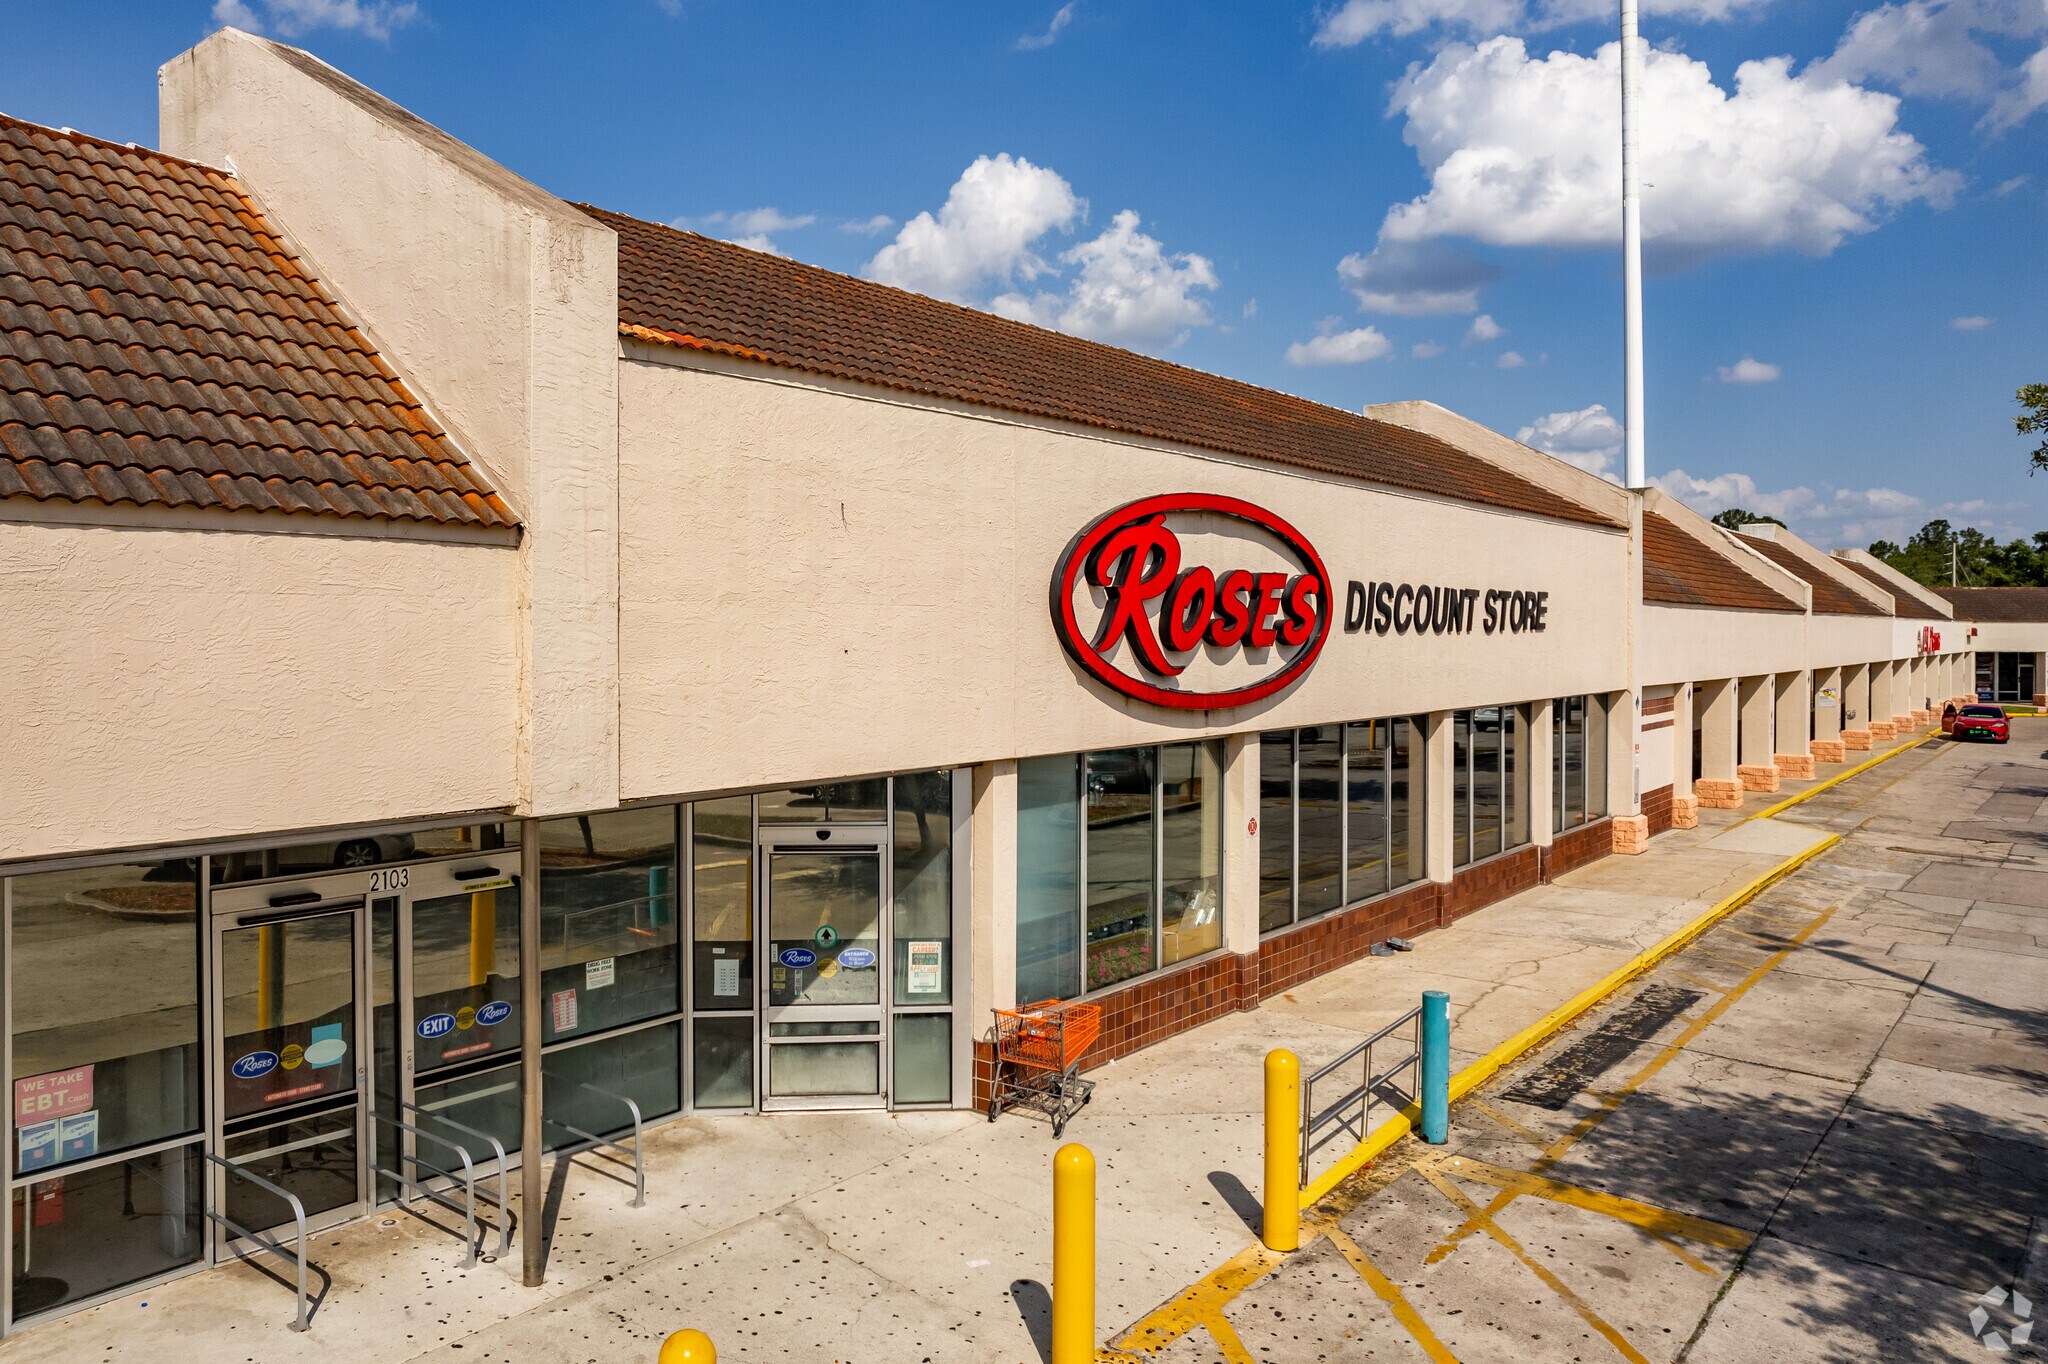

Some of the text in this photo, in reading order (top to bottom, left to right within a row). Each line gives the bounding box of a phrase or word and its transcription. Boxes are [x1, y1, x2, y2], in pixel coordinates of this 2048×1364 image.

[1085, 513, 1319, 676] ROSES
[1344, 580, 1549, 636] DISCOUNT STORE
[370, 868, 409, 892] 2103
[423, 1017, 450, 1035] EXIT
[22, 1072, 84, 1093] WE TAKE
[21, 1089, 69, 1115] EBT
[68, 1092, 89, 1103] Cash
